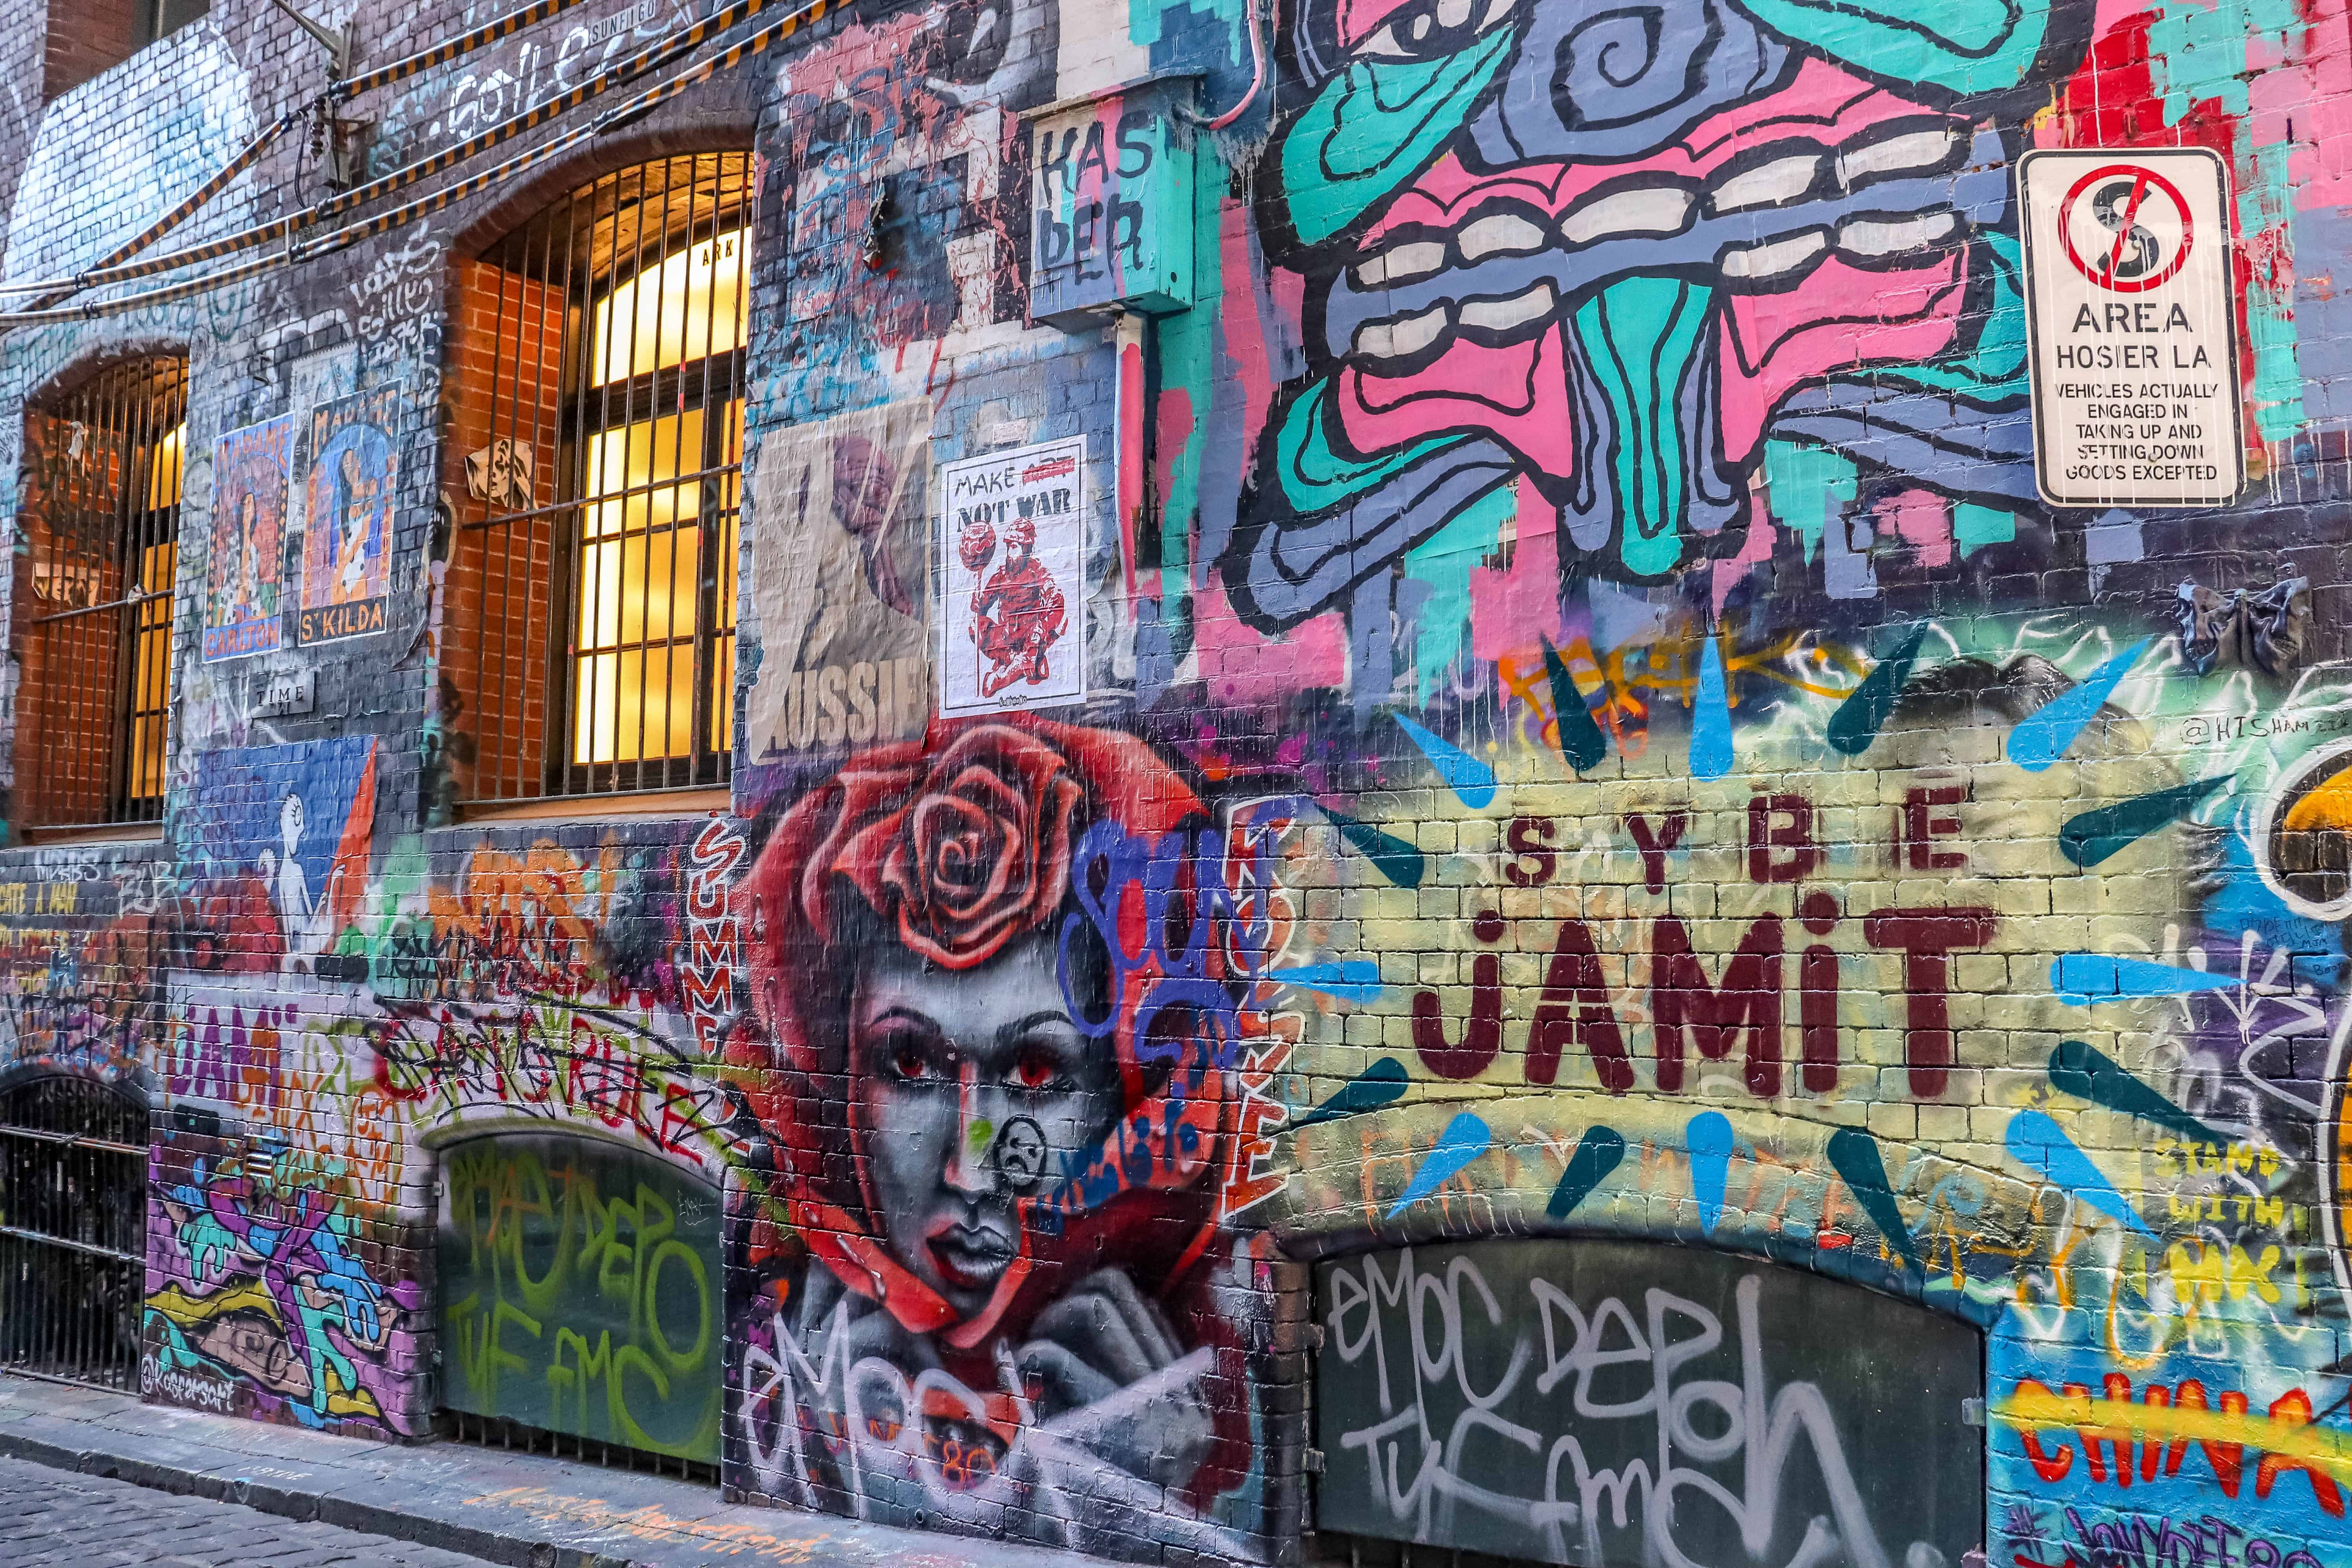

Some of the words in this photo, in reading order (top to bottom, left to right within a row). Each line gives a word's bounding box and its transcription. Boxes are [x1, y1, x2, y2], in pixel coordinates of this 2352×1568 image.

[592, 0, 654, 42] SUNFIGO
[2071, 303, 2193, 333] AREA
[2057, 344, 2158, 369] HOSIER
[2174, 345, 2211, 369] LA
[2055, 383, 2132, 399] VEHICLES
[2139, 383, 2218, 399] ACTUALLY
[2087, 404, 2166, 419] ENGAGED
[2173, 405, 2188, 419] IN
[2076, 424, 2134, 439] TAKING
[2140, 424, 2161, 439] UP
[2168, 424, 2202, 439] AND
[2078, 444, 2146, 459] SETTING
[2152, 444, 2203, 459] DOWN
[955, 467, 1015, 497] MAKE
[2066, 465, 2126, 480] GOODS
[2133, 465, 2217, 480] EXCEPTED
[957, 500, 1009, 532] NOT
[1016, 488, 1071, 517] WAR
[323, 603, 382, 637] KILDA
[205, 622, 279, 657] CARLTON
[257, 686, 304, 706] TIME
[1506, 783, 1970, 895] SYBE
[2154, 1138, 2281, 1180] STAND
[2170, 1194, 2284, 1228] WITH
[2014, 1372, 2346, 1519] CHINA
